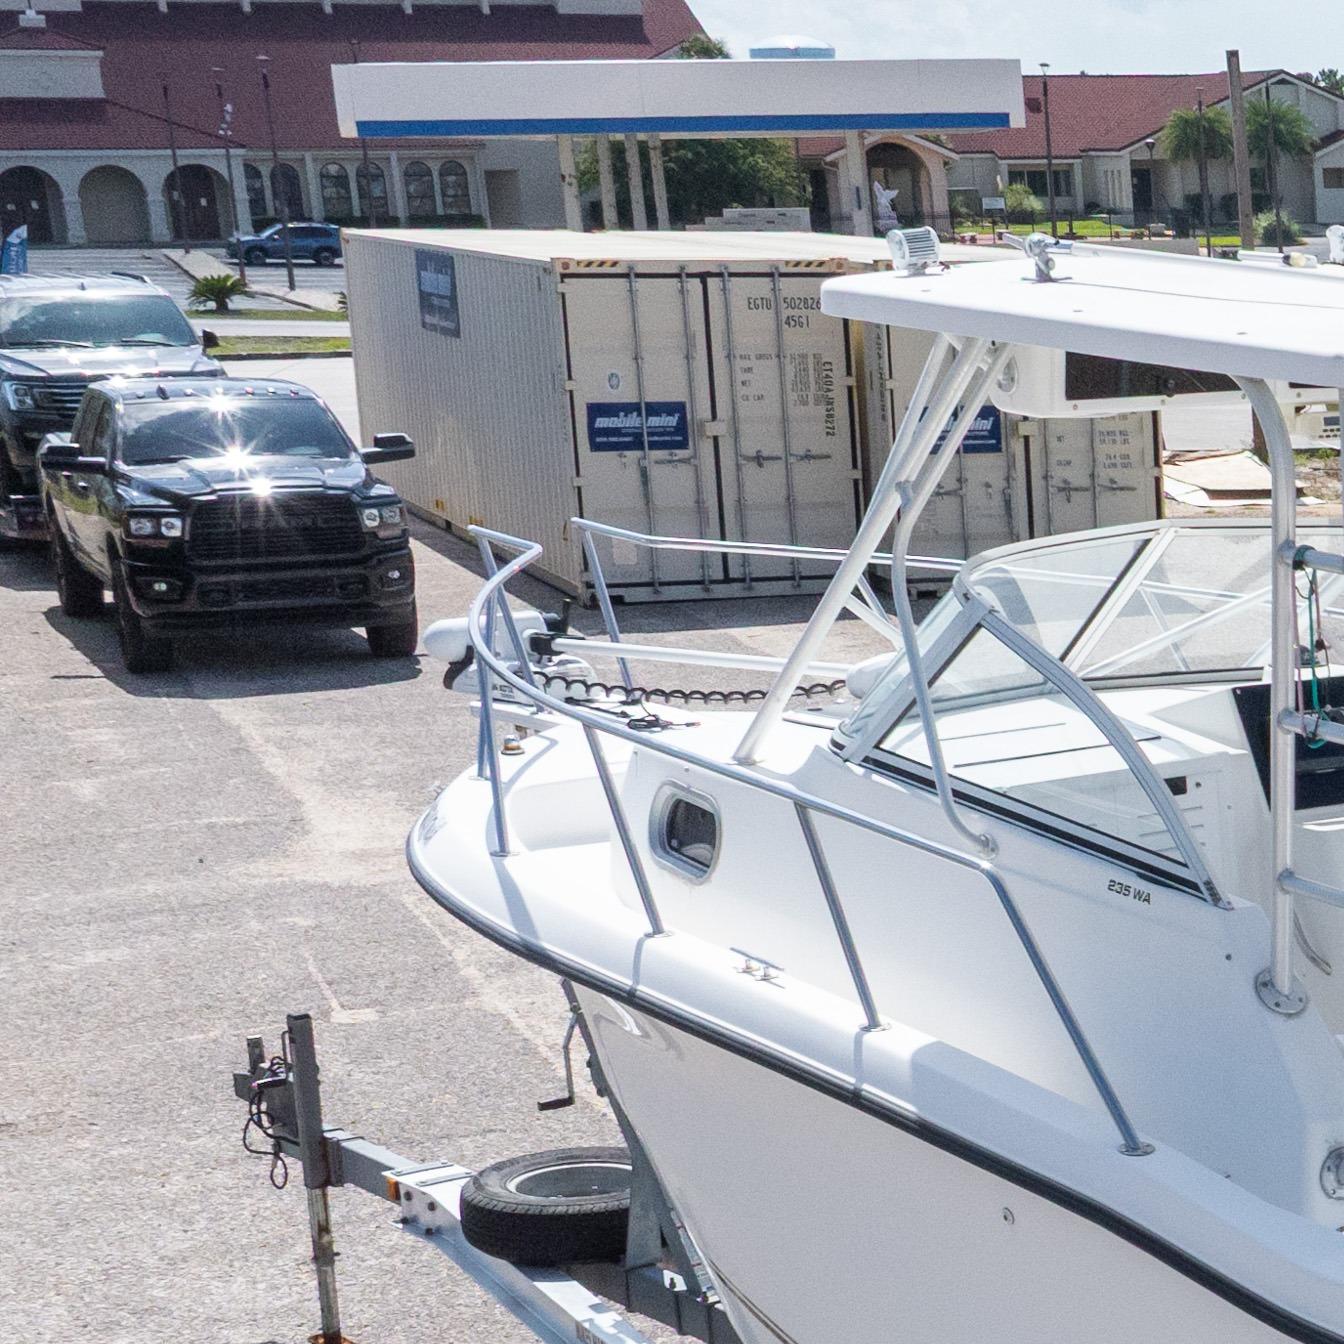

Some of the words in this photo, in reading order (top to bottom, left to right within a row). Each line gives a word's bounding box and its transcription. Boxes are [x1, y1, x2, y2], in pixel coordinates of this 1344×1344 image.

[747, 297, 772, 310] EGTU
[784, 315, 810, 328] 45G1
[647, 413, 680, 427] mini
[1107, 879, 1132, 897] 235
[1133, 887, 1151, 905] WA
